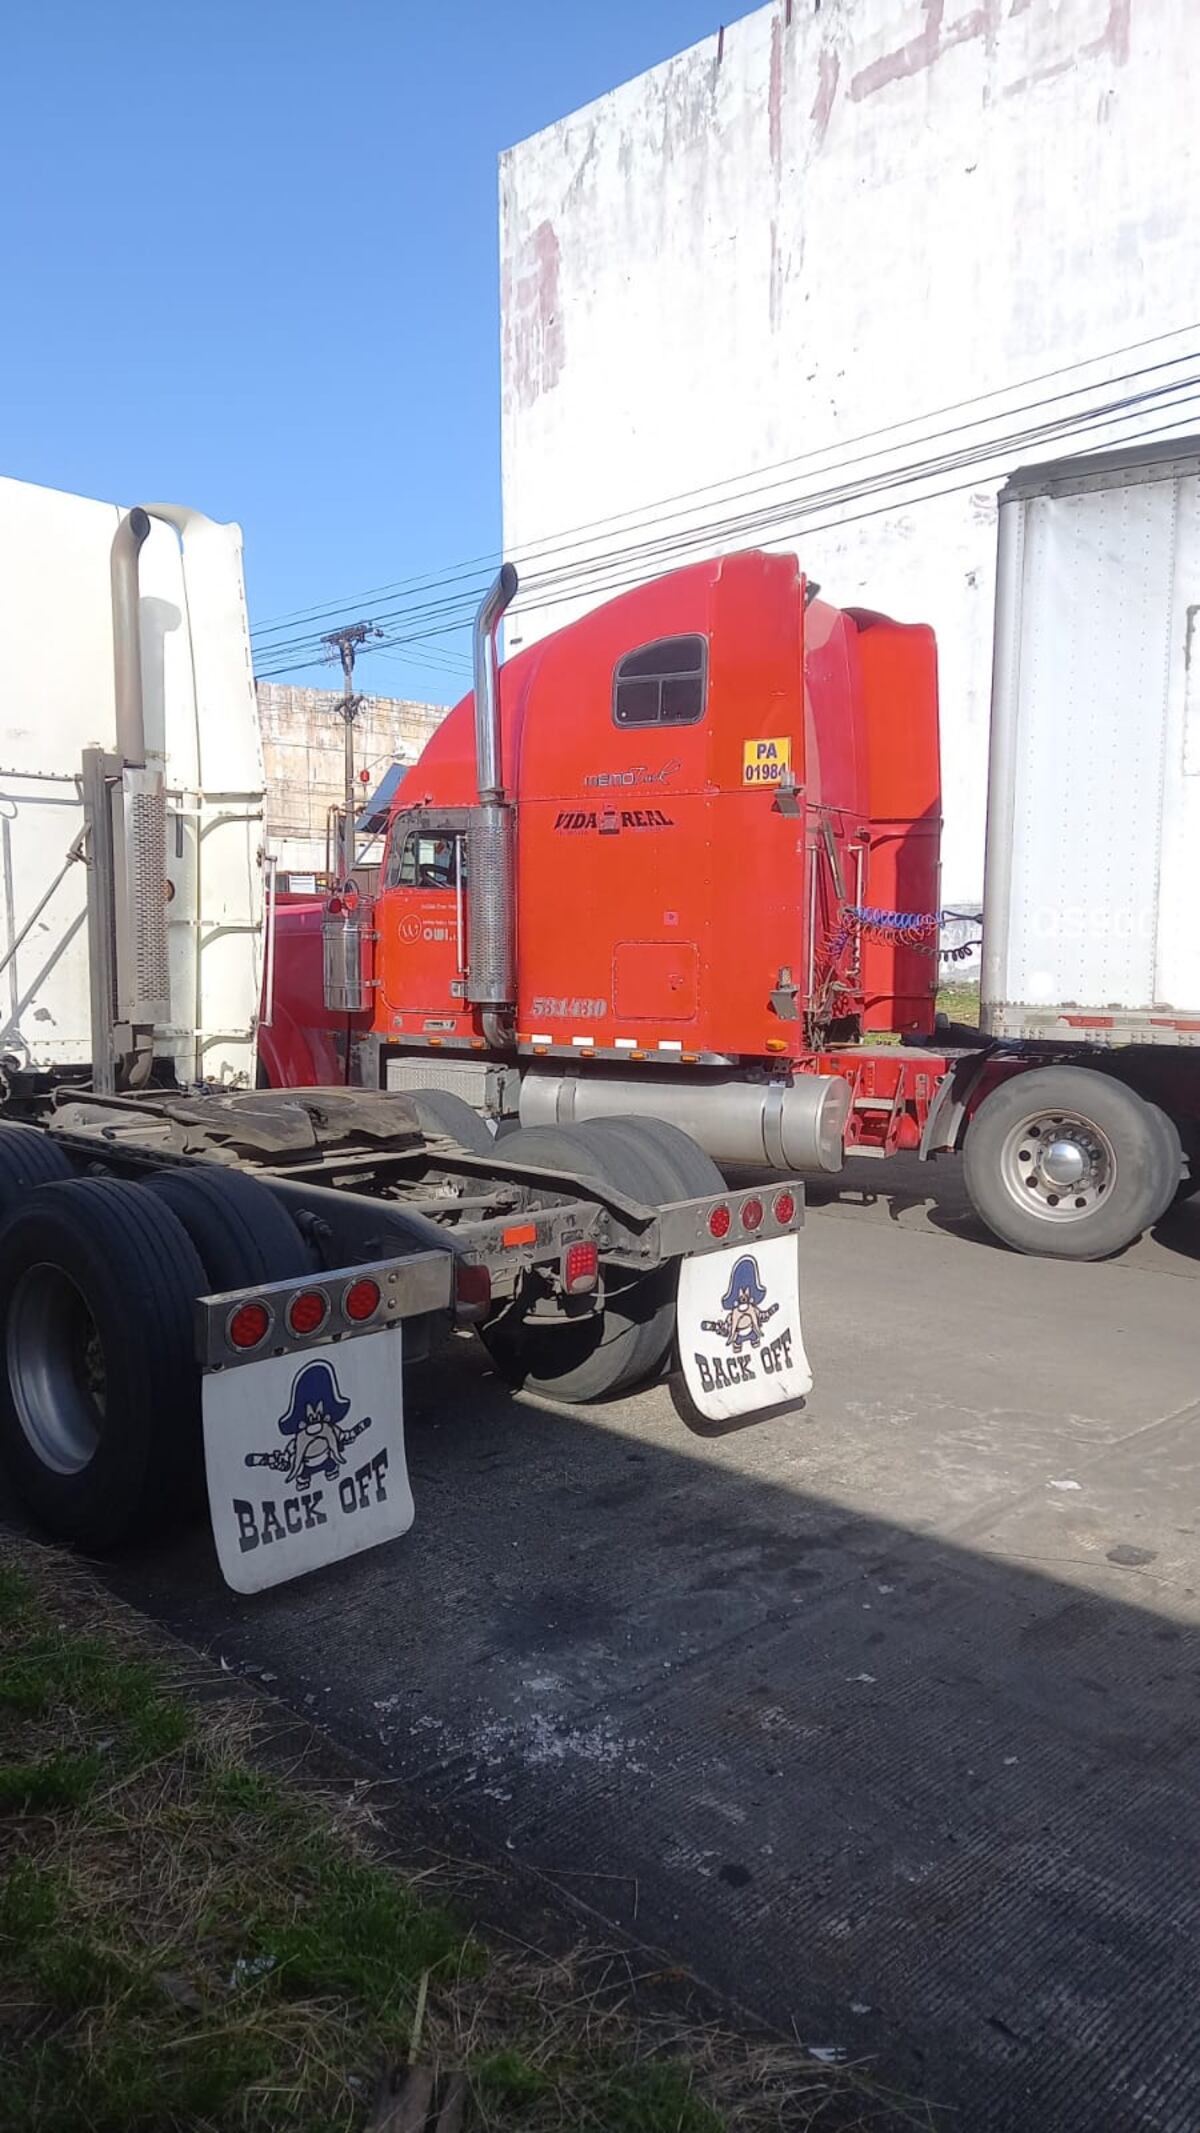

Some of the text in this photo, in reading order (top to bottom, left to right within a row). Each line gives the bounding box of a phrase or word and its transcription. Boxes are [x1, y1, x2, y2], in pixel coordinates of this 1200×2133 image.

[757, 742, 778, 760] PA
[554, 809, 674, 830] VIDA REAL
[694, 1327, 794, 1393] BACK OFF
[232, 1447, 389, 1554] BACK OFF
